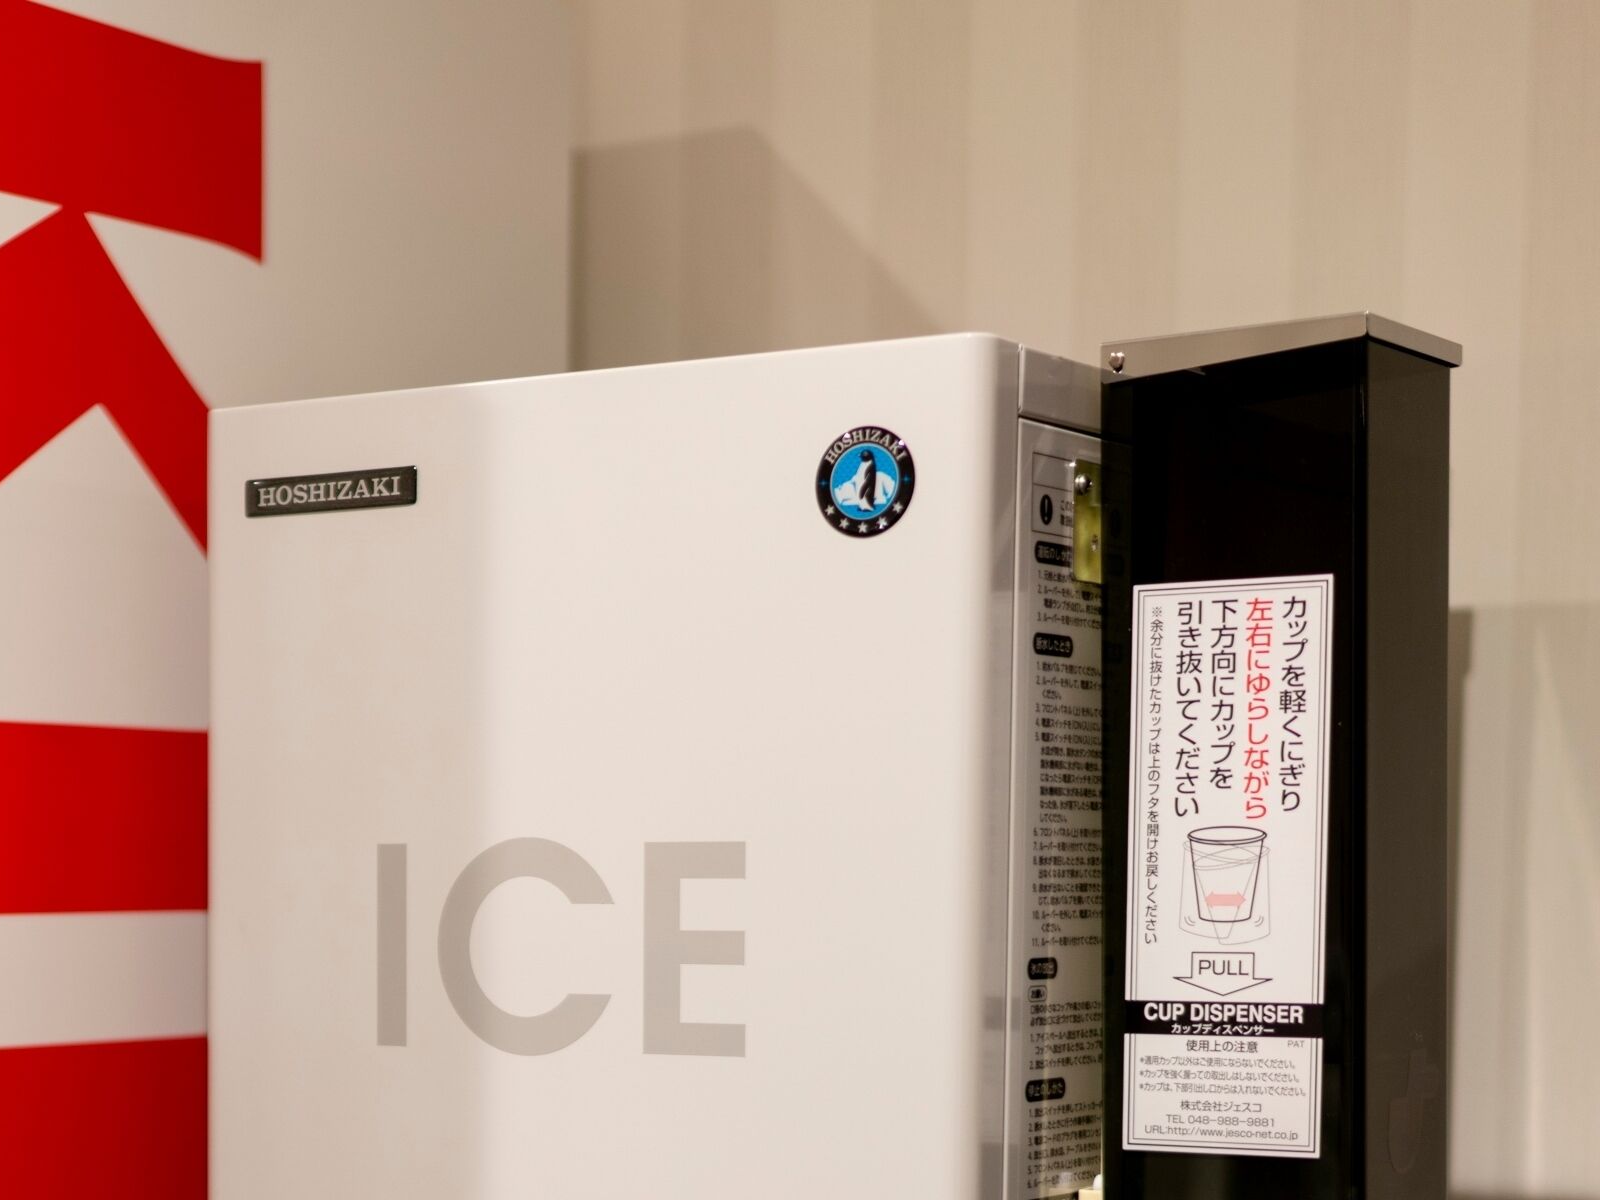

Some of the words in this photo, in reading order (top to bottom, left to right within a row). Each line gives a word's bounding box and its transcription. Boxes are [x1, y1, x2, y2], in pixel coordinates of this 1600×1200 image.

[825, 428, 908, 465] HOSHIZAKI
[256, 475, 402, 508] HOSHIZAKI
[1174, 600, 1203, 818] 引き抜いてください
[1209, 599, 1239, 790] 下方向にカップを
[1242, 597, 1274, 820] 左右にゆらしながら
[1278, 595, 1308, 814] カップを軽くにぎり
[376, 836, 747, 1058] ICE
[1198, 959, 1250, 977] PULL
[1143, 1002, 1186, 1022] CUP
[1190, 1003, 1304, 1024] DISPENSER
[1171, 1023, 1275, 1035] カップディスペンサー
[1186, 1039, 1259, 1054] 使用上の注意
[1287, 1039, 1305, 1049] PAT
[1166, 1113, 1185, 1124] TEL
[1180, 1100, 1263, 1113] 株式会社ジェスコ
